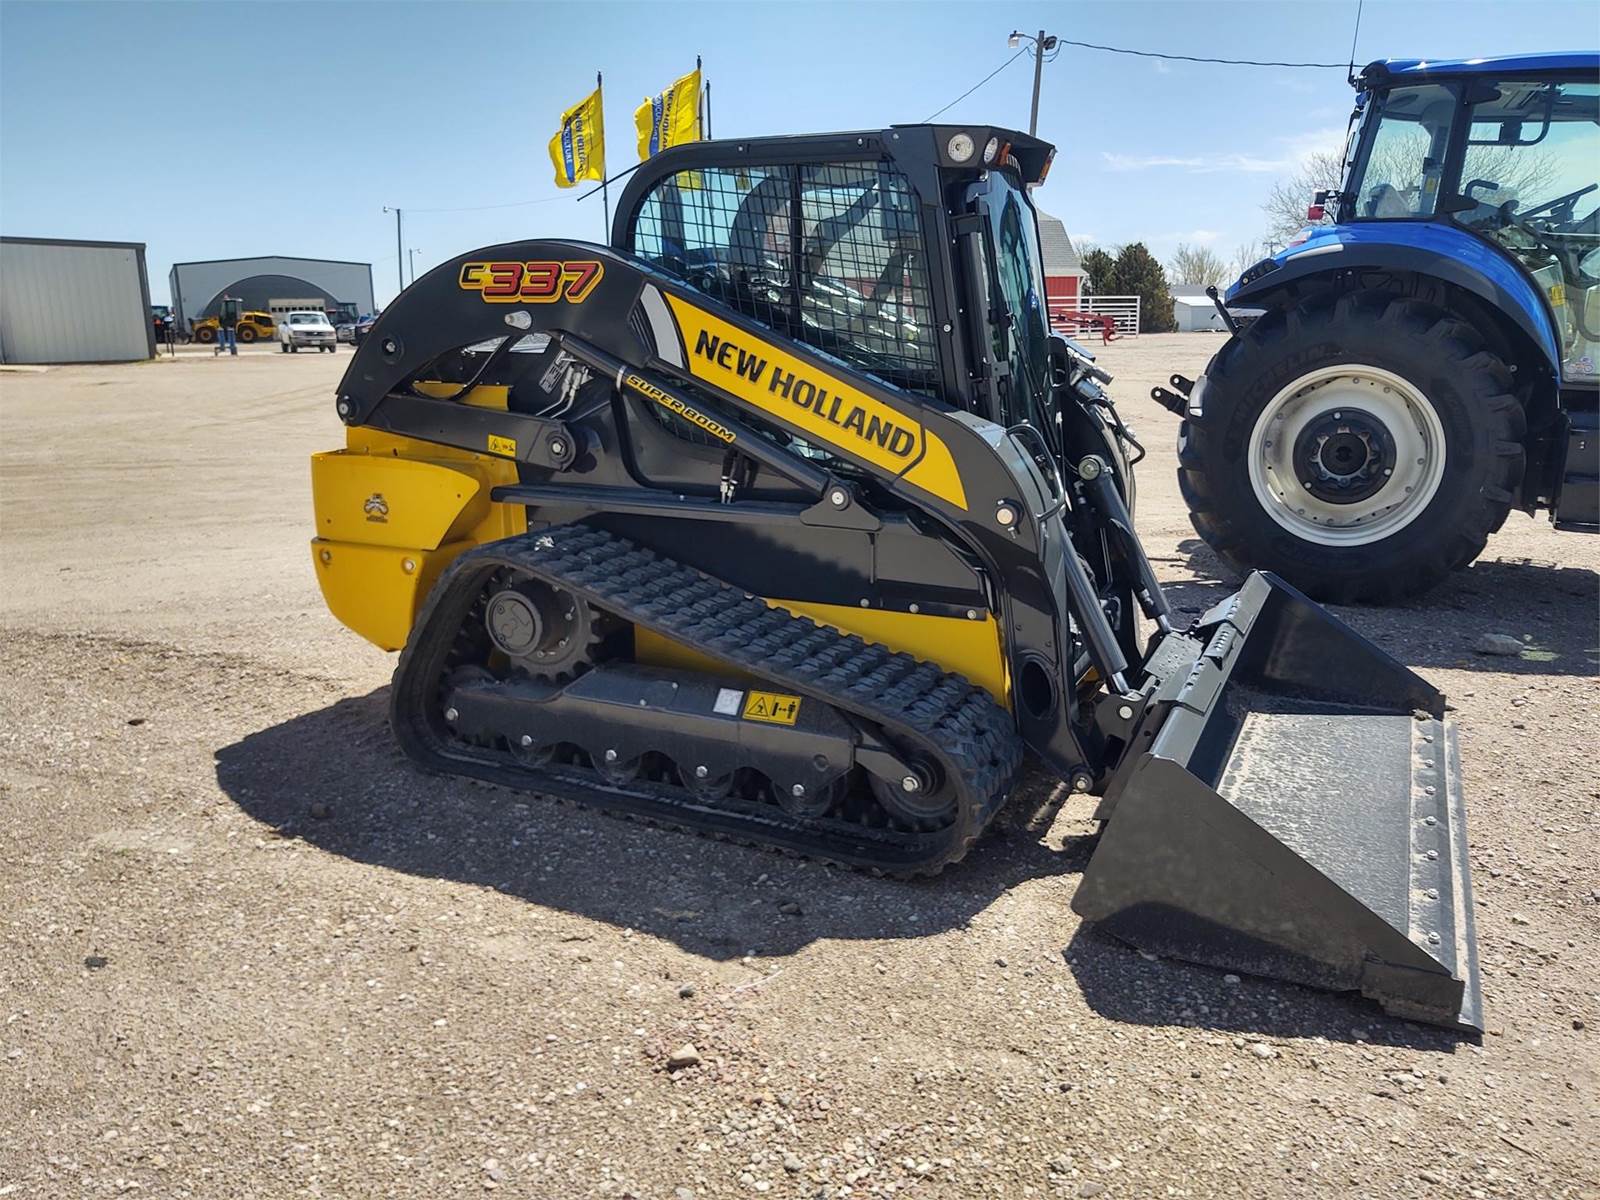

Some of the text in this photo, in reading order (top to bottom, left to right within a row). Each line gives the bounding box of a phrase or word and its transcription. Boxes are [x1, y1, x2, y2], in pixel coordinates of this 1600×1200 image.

[662, 114, 670, 151] HOLLAN
[459, 260, 605, 304] C337
[694, 329, 915, 458] NEW HOLLAND
